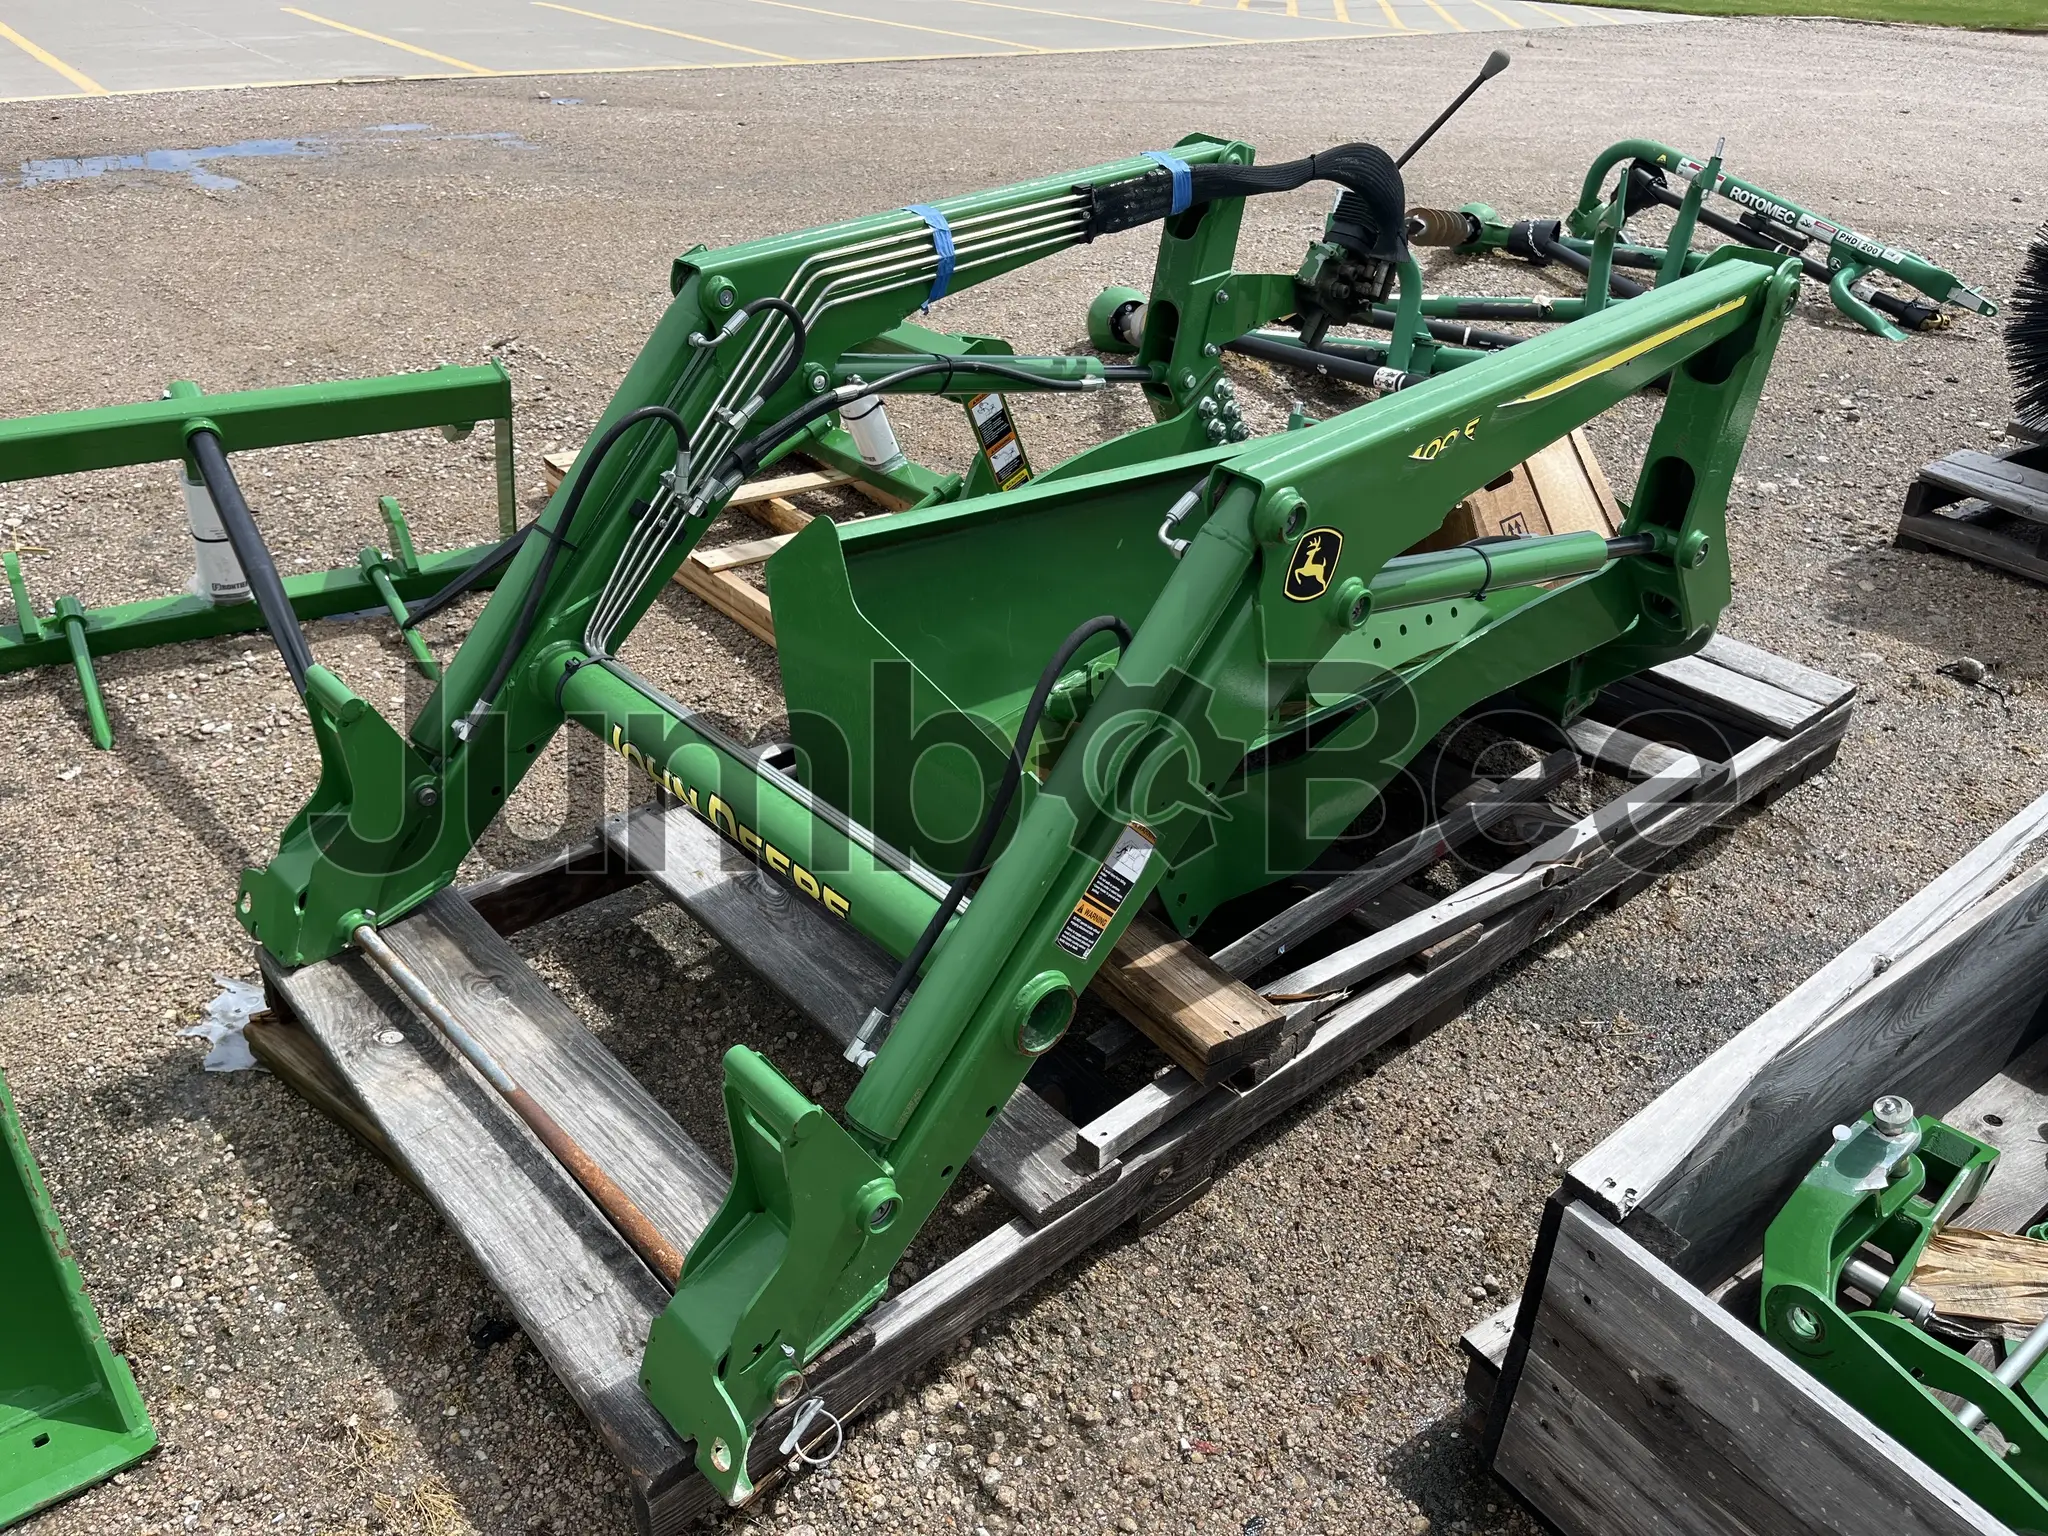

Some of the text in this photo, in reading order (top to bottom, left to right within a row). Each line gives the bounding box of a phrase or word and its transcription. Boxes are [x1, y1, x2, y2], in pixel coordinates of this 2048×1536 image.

[1729, 185, 1797, 226] ROTOMEC
[1838, 232, 1879, 256] PHD 200
[1083, 907, 1109, 928] WARNING
